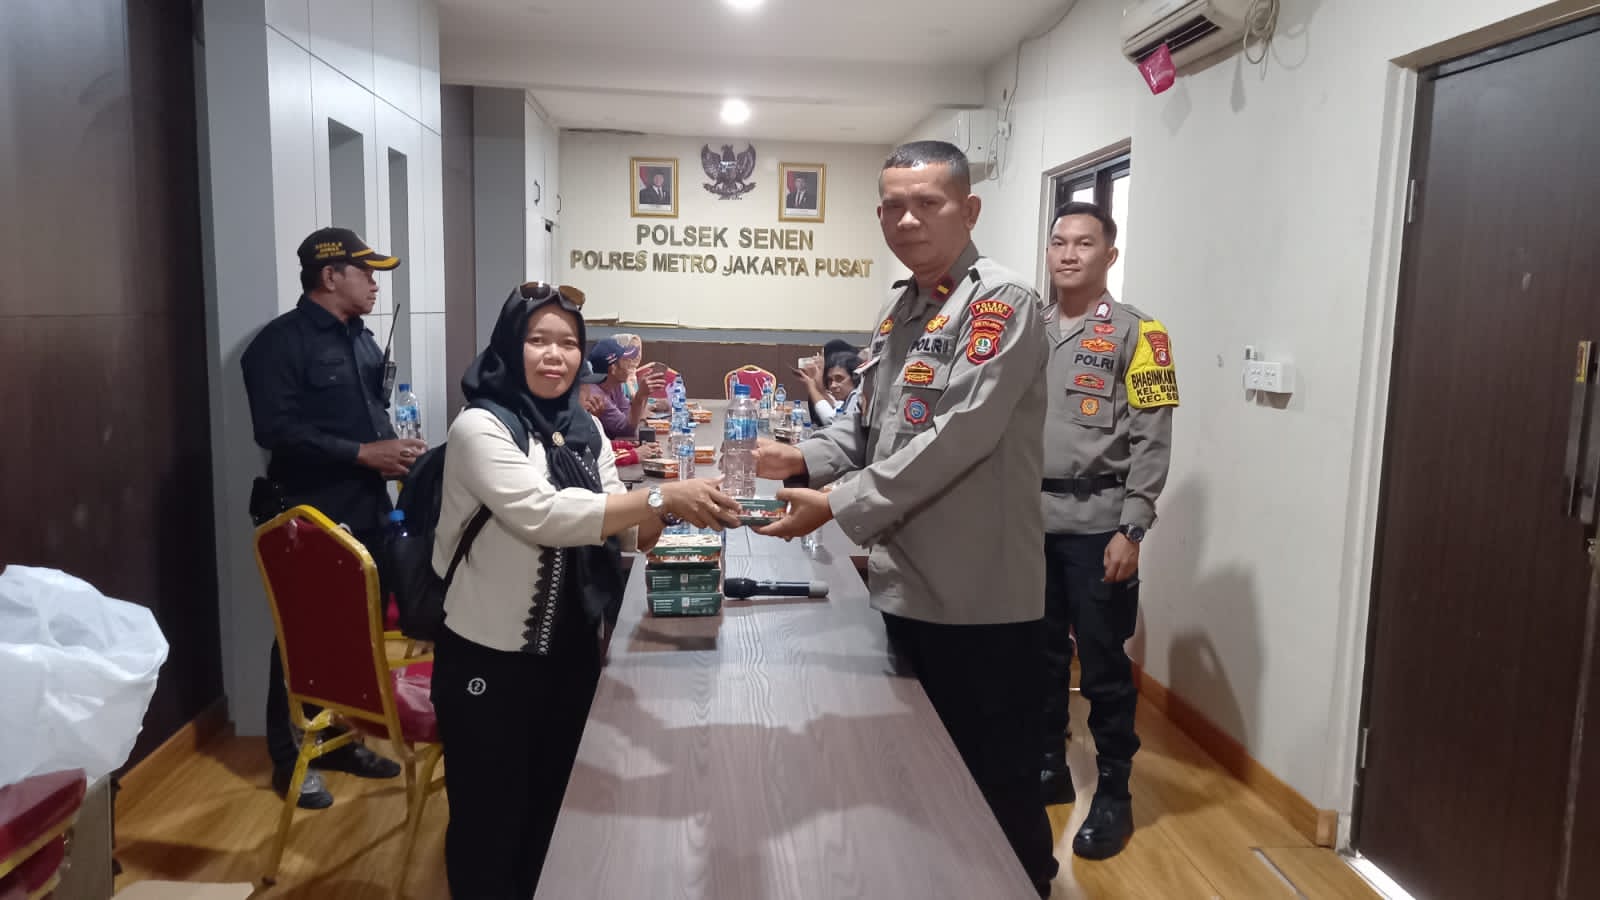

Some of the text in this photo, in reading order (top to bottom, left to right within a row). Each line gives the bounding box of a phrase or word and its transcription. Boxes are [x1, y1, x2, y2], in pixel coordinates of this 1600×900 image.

[636, 224, 814, 250] POLSEK SENEN
[570, 250, 874, 278] POLRES METRO JAKARTA PUSAT
[910, 338, 949, 352] POLRI
[1074, 353, 1115, 370] POLRI
